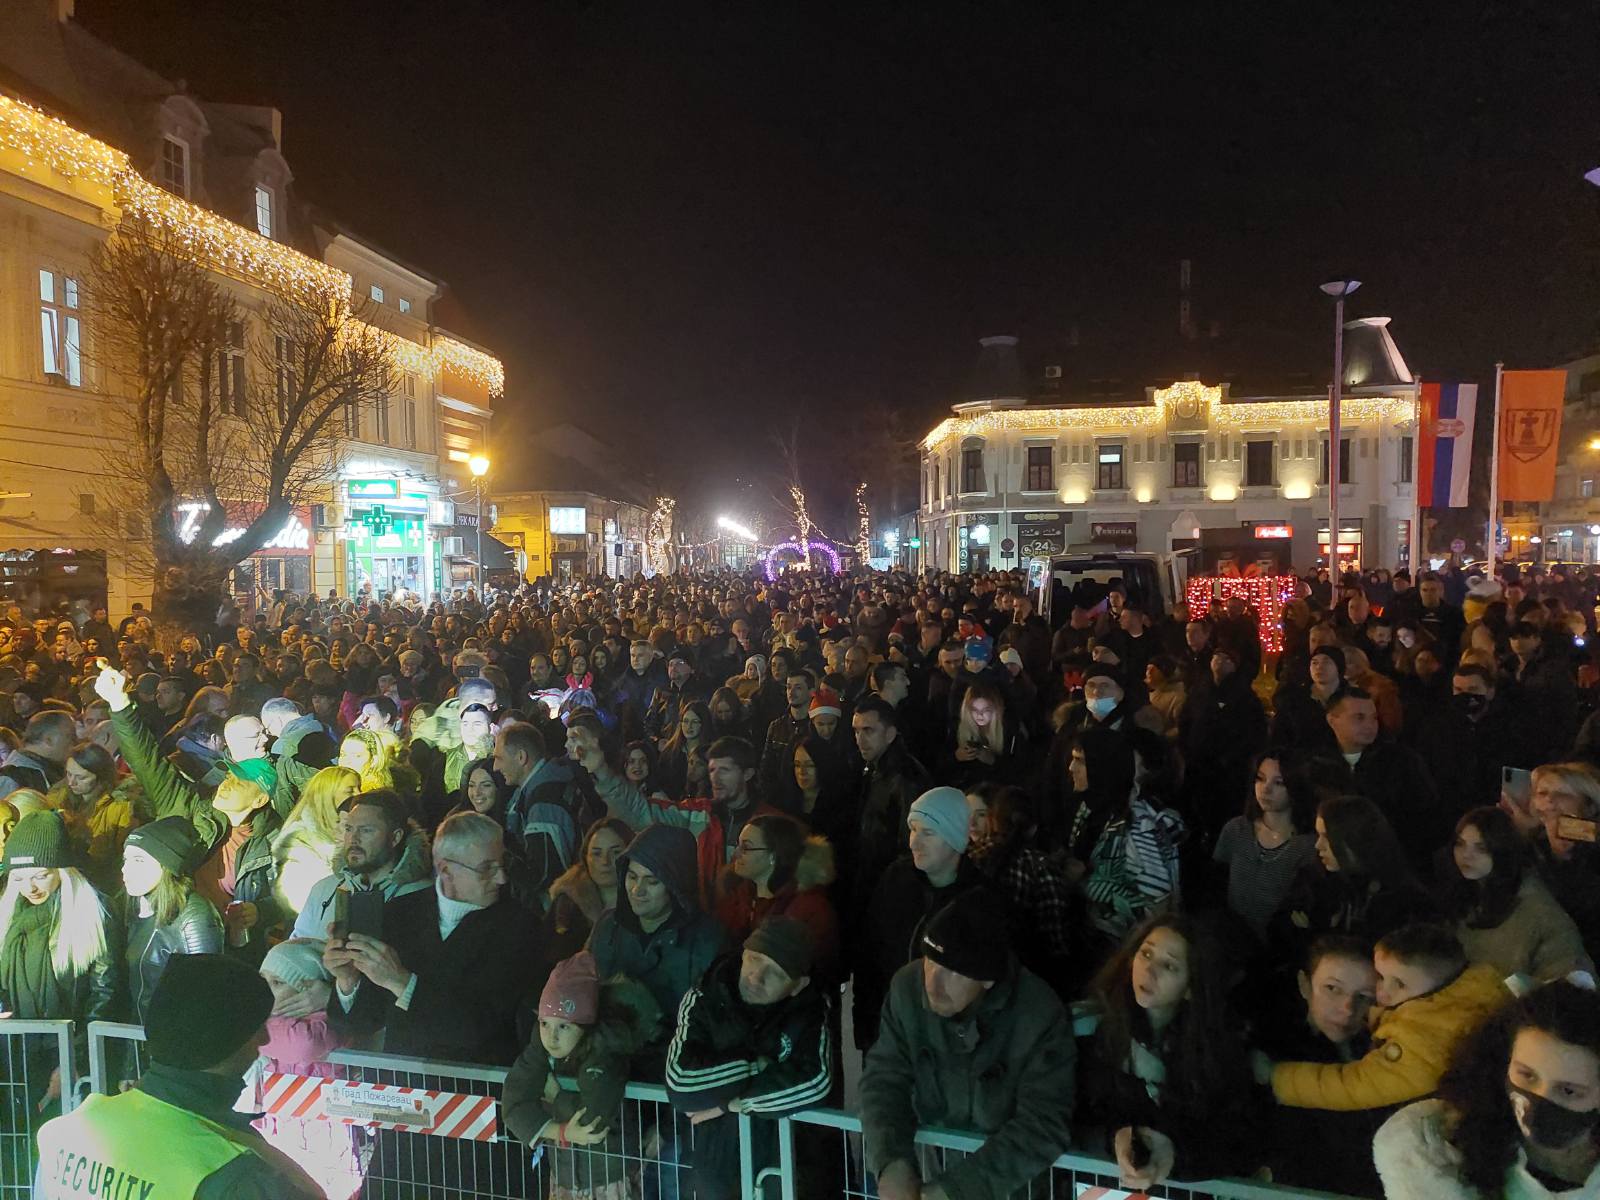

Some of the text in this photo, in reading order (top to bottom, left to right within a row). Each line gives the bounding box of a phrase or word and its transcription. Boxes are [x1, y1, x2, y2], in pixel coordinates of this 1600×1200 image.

[1034, 541, 1049, 551] 24
[342, 1088, 411, 1105] Град Пожаревац
[53, 1148, 155, 1200] SECURITY
